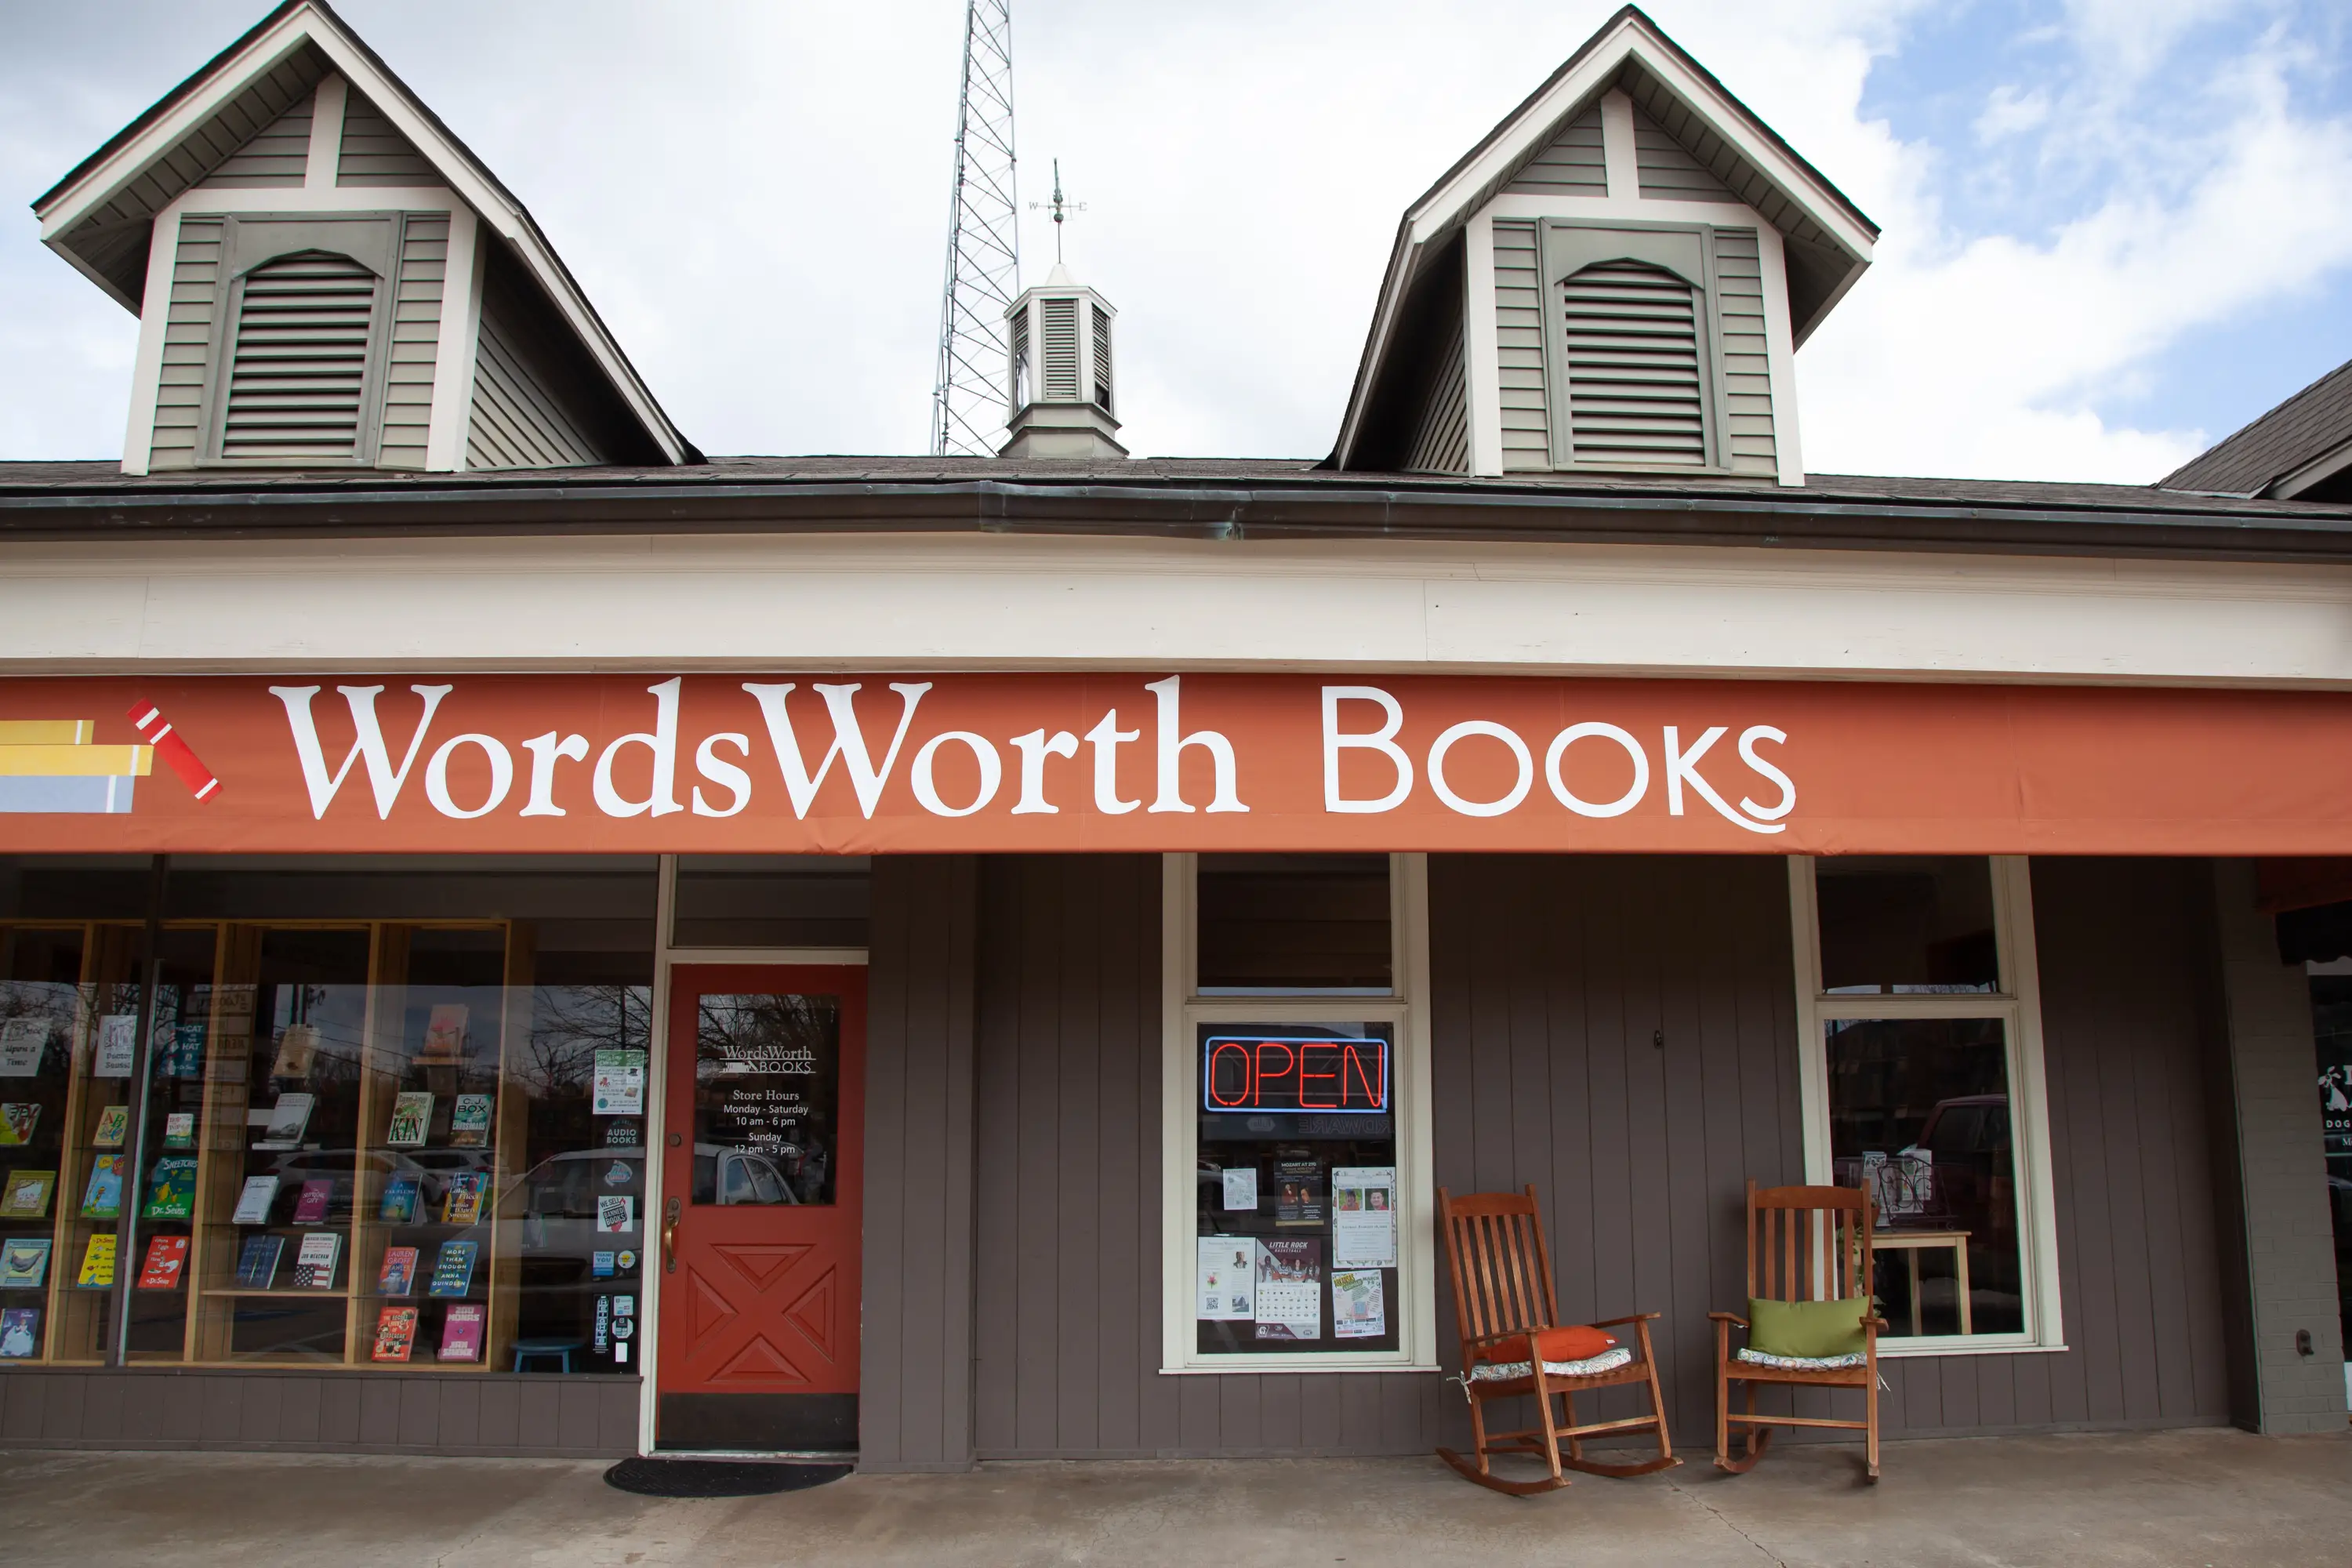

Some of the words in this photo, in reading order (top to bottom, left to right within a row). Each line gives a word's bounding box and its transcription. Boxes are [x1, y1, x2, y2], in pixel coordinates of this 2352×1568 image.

[268, 676, 1251, 821] WordsWorth
[182, 1042, 201, 1051] HAT
[723, 1045, 813, 1060] WordsWorth
[759, 1061, 812, 1074] BOOKS
[1211, 1043, 1382, 1108] OPEN
[733, 1090, 762, 1101] Store
[766, 1090, 800, 1101] Hours
[724, 1105, 760, 1115] Monday
[769, 1105, 808, 1116] Saturday
[736, 1117, 747, 1126] 10
[772, 1117, 779, 1126] 6
[390, 1118, 423, 1142] KIN
[749, 1132, 782, 1143] Sunday
[735, 1145, 746, 1153] 12
[163, 1160, 198, 1170] SNEETCHES
[600, 1200, 608, 1208] WE
[608, 1197, 620, 1206] SELL
[152, 1206, 164, 1215] Dr.
[165, 1203, 187, 1215] Seuss
[604, 1207, 624, 1218] BANNED
[606, 1214, 626, 1225] BOOKS
[597, 1299, 608, 1344] HEIGHTS
